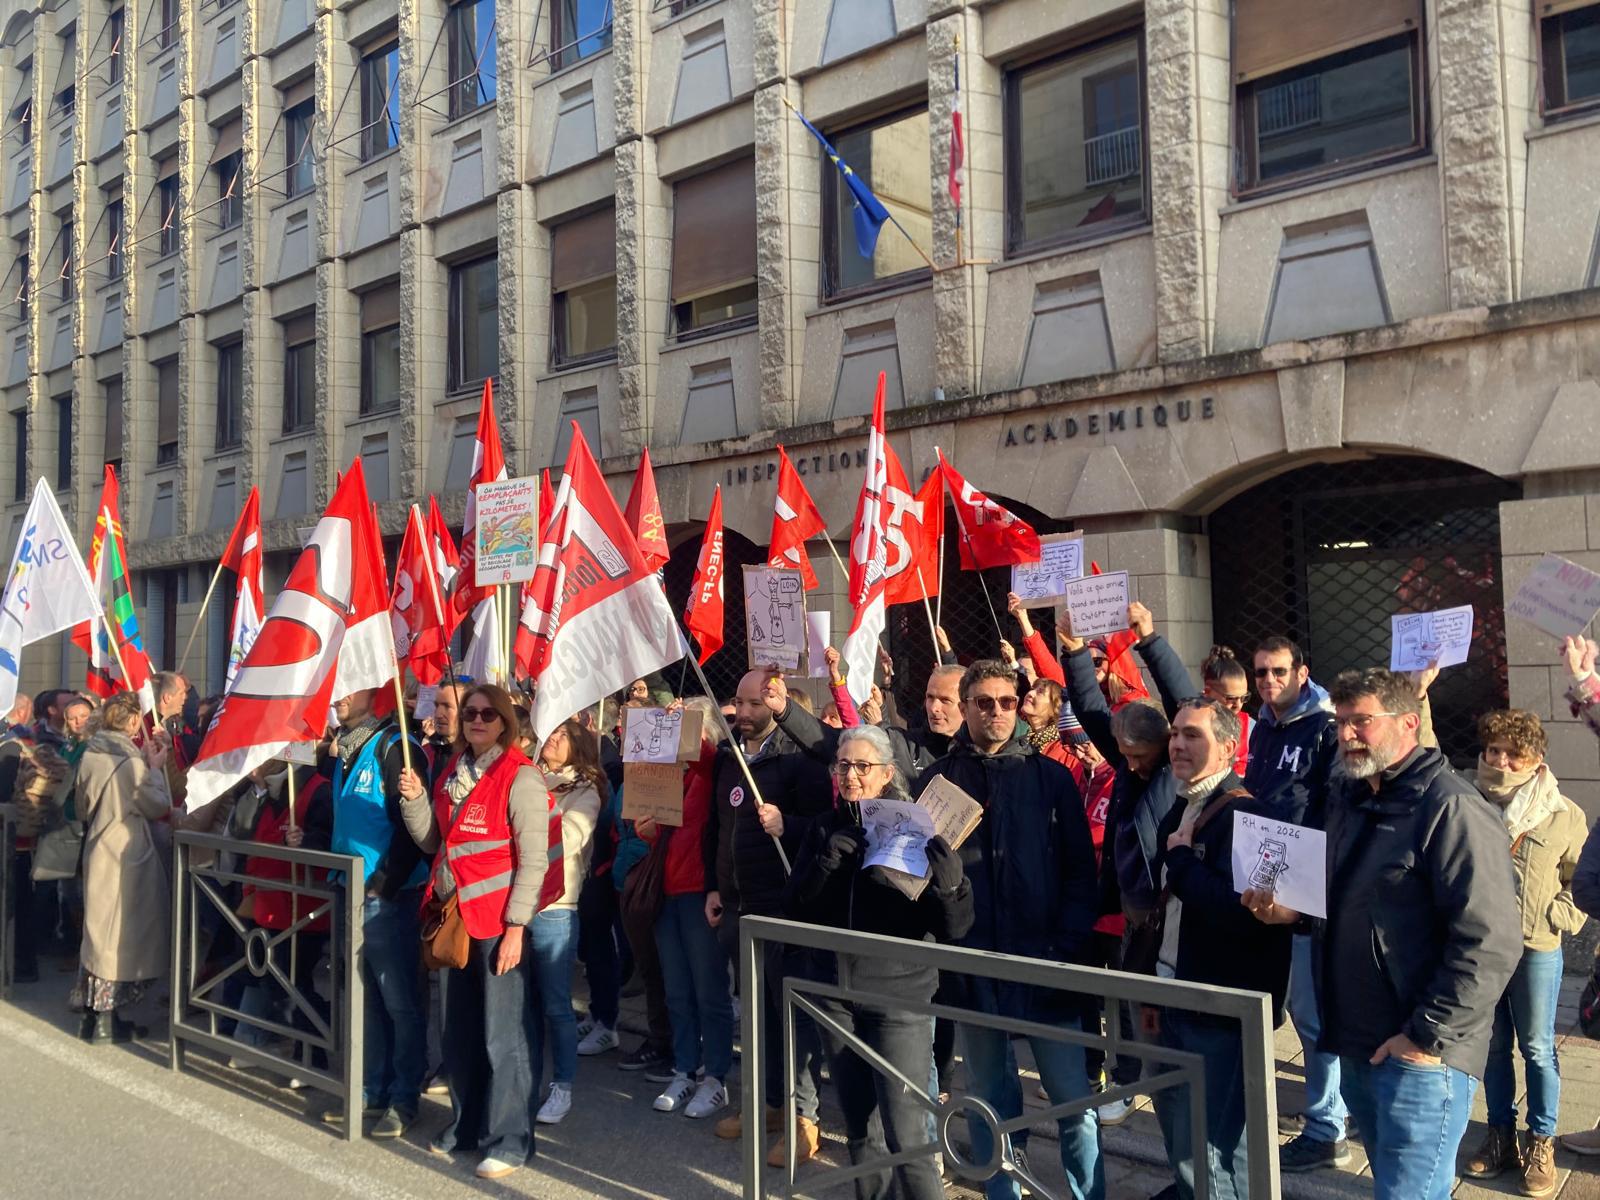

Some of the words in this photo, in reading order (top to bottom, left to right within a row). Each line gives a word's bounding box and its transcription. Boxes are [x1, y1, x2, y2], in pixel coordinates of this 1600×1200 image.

[727, 449, 868, 486] INSPCTION
[1004, 397, 1214, 447] ACADEMIQUE
[1276, 745, 1303, 772] M
[1242, 816, 1256, 829] RH
[1276, 825, 1300, 839] 2026
